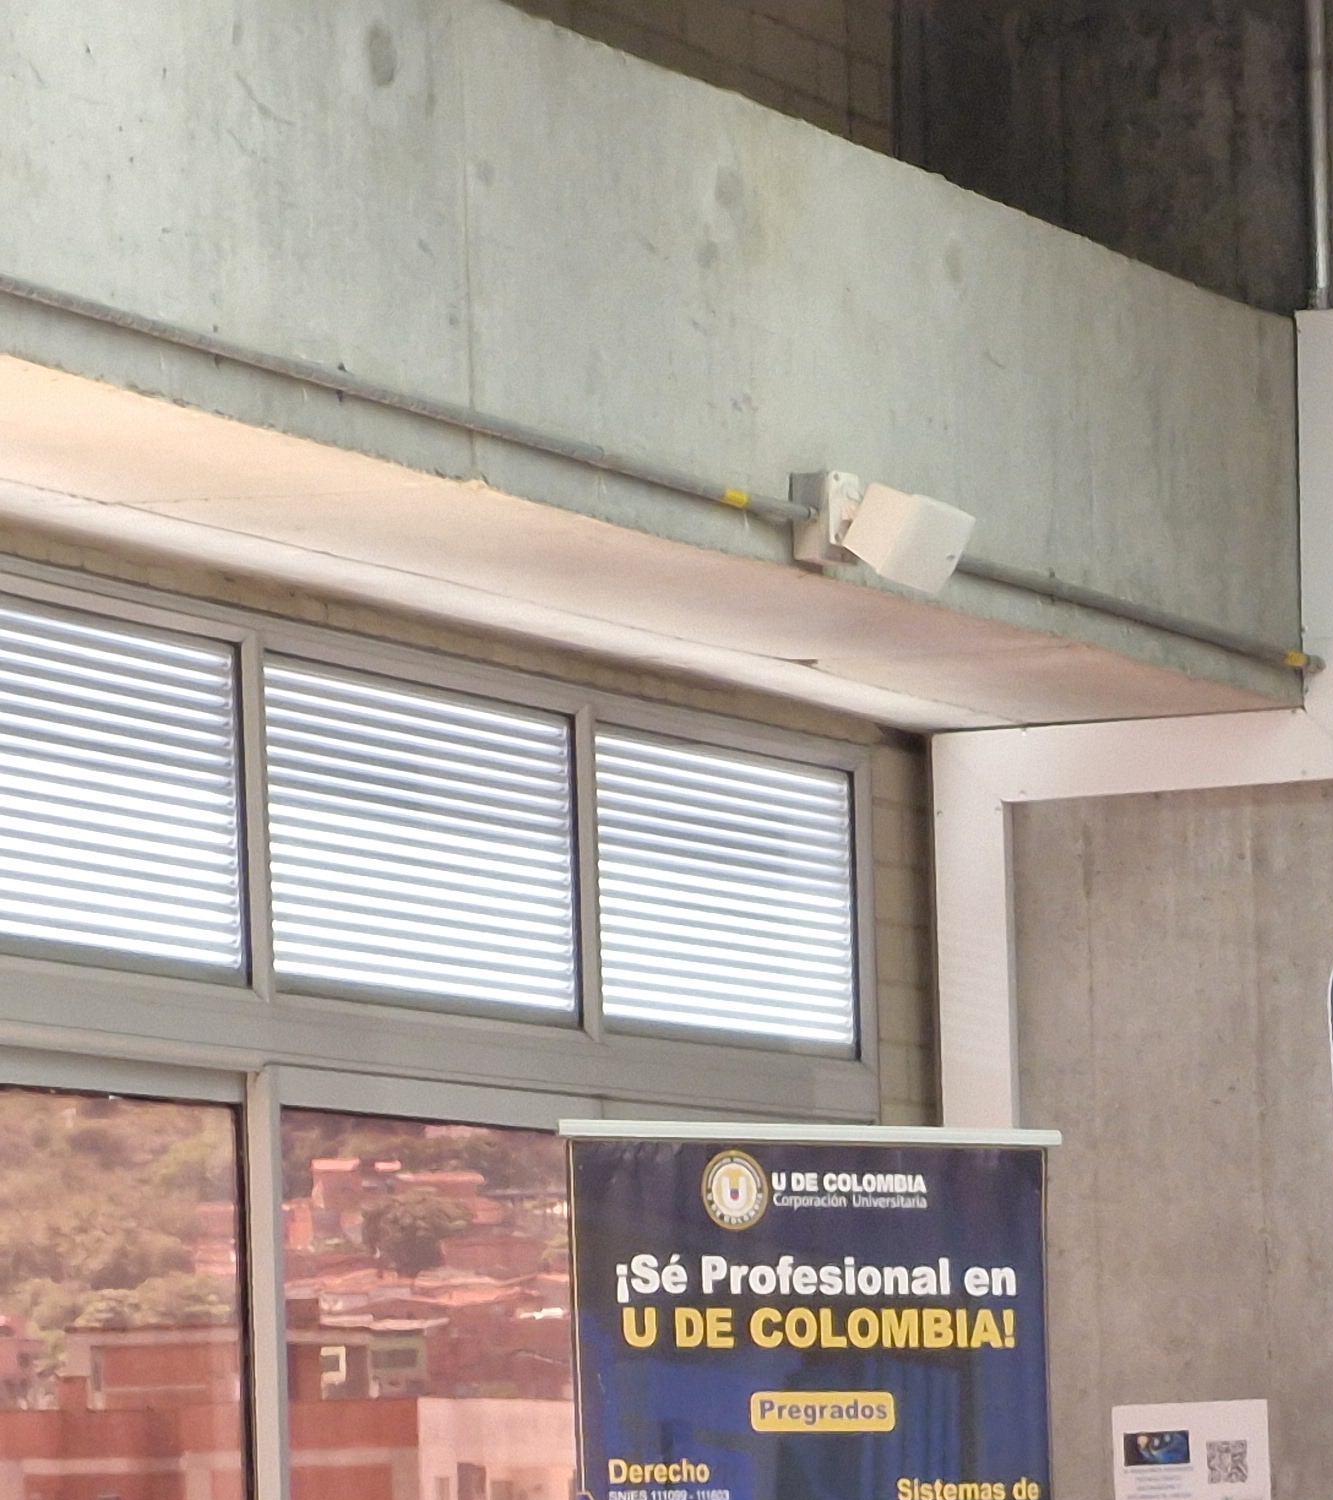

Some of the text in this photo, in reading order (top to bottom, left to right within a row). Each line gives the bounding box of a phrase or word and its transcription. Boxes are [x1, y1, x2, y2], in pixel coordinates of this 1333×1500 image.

[771, 1172, 927, 1193] U DE COLOMBIA
[772, 1193, 928, 1211] Corporación Universitaria
[616, 1253, 1017, 1303] ¡Sé Profesional en
[622, 1307, 1016, 1349] U DE COLOMBIA!
[759, 1400, 889, 1425] Pregrados
[608, 1458, 711, 1484] Derecho
